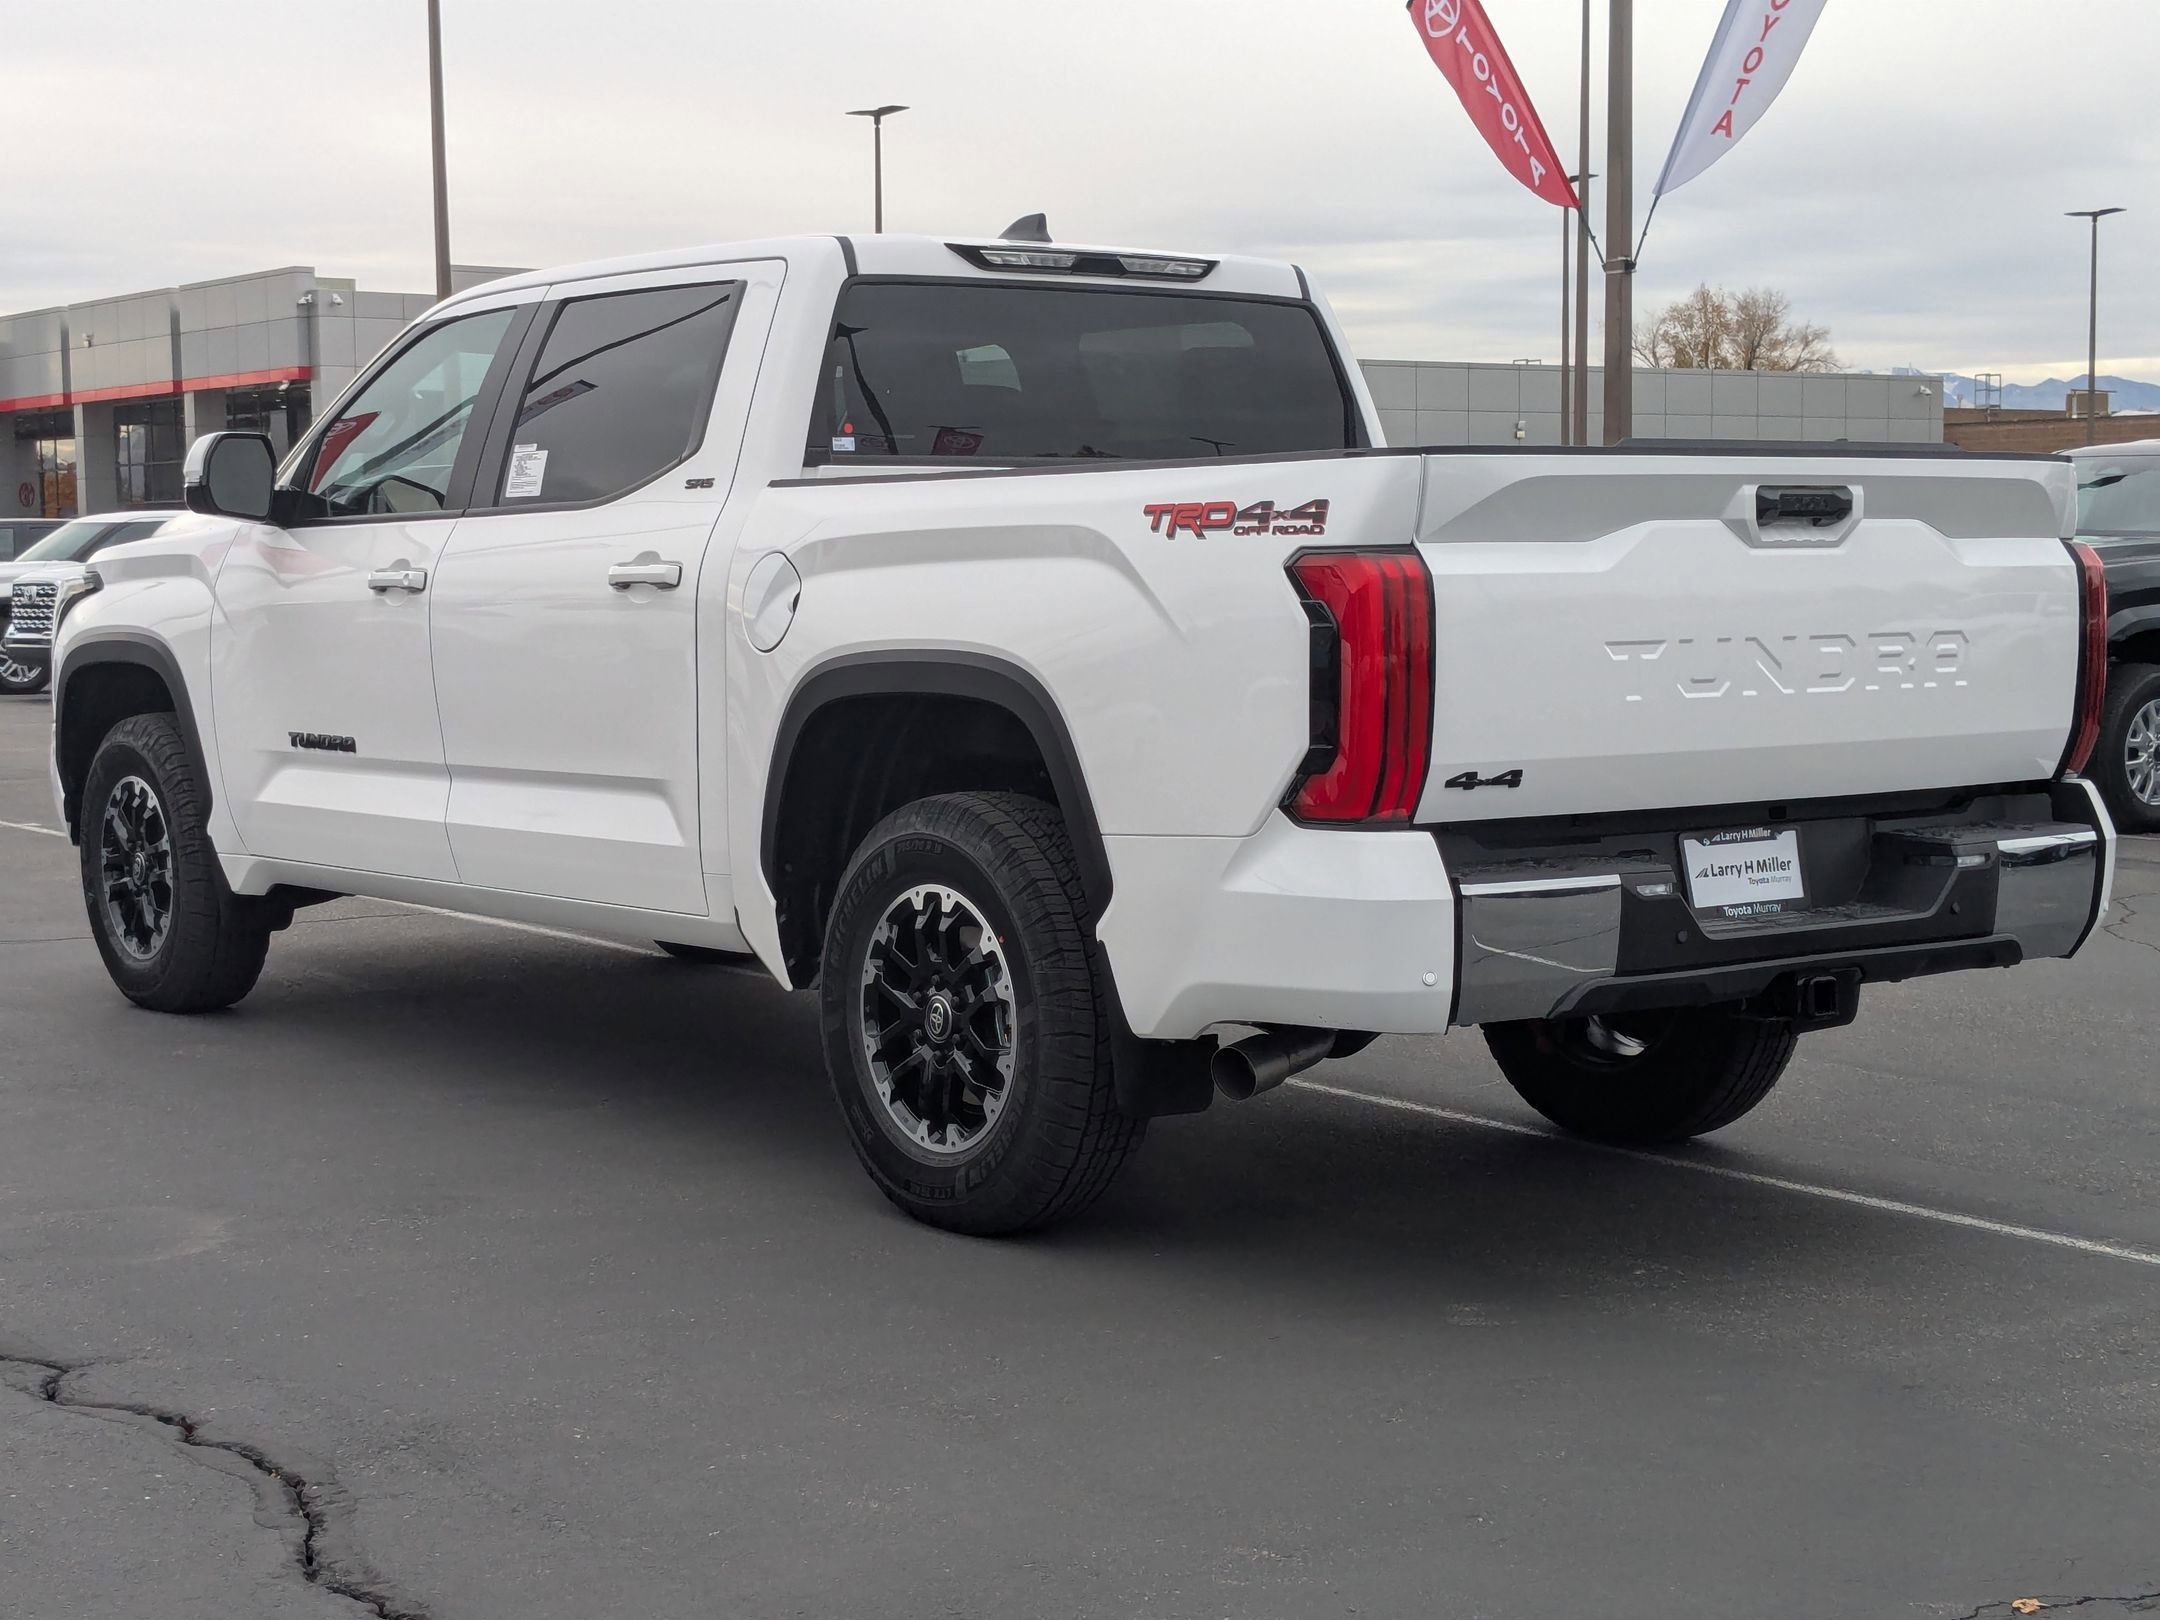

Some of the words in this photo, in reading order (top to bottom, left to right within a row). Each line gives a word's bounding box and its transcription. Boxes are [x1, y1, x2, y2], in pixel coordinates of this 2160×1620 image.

[1455, 26, 1546, 187] TOYOTA
[1143, 501, 1237, 540] TRD
[1233, 525, 1270, 536] OFF
[1271, 524, 1325, 536] ROAD
[1604, 630, 1969, 702] TUNDRA
[288, 731, 357, 753] TUNDRA
[1720, 832, 1740, 841] Larry
[1741, 830, 1748, 839] H
[1748, 827, 1771, 838] Miller
[1711, 863, 1742, 878] Larry
[1745, 861, 1753, 874] H
[1757, 856, 1791, 871] Miller
[1748, 877, 1770, 885] Toyota
[1723, 905, 1752, 918] Toyota
[1753, 903, 1781, 914] Murray
